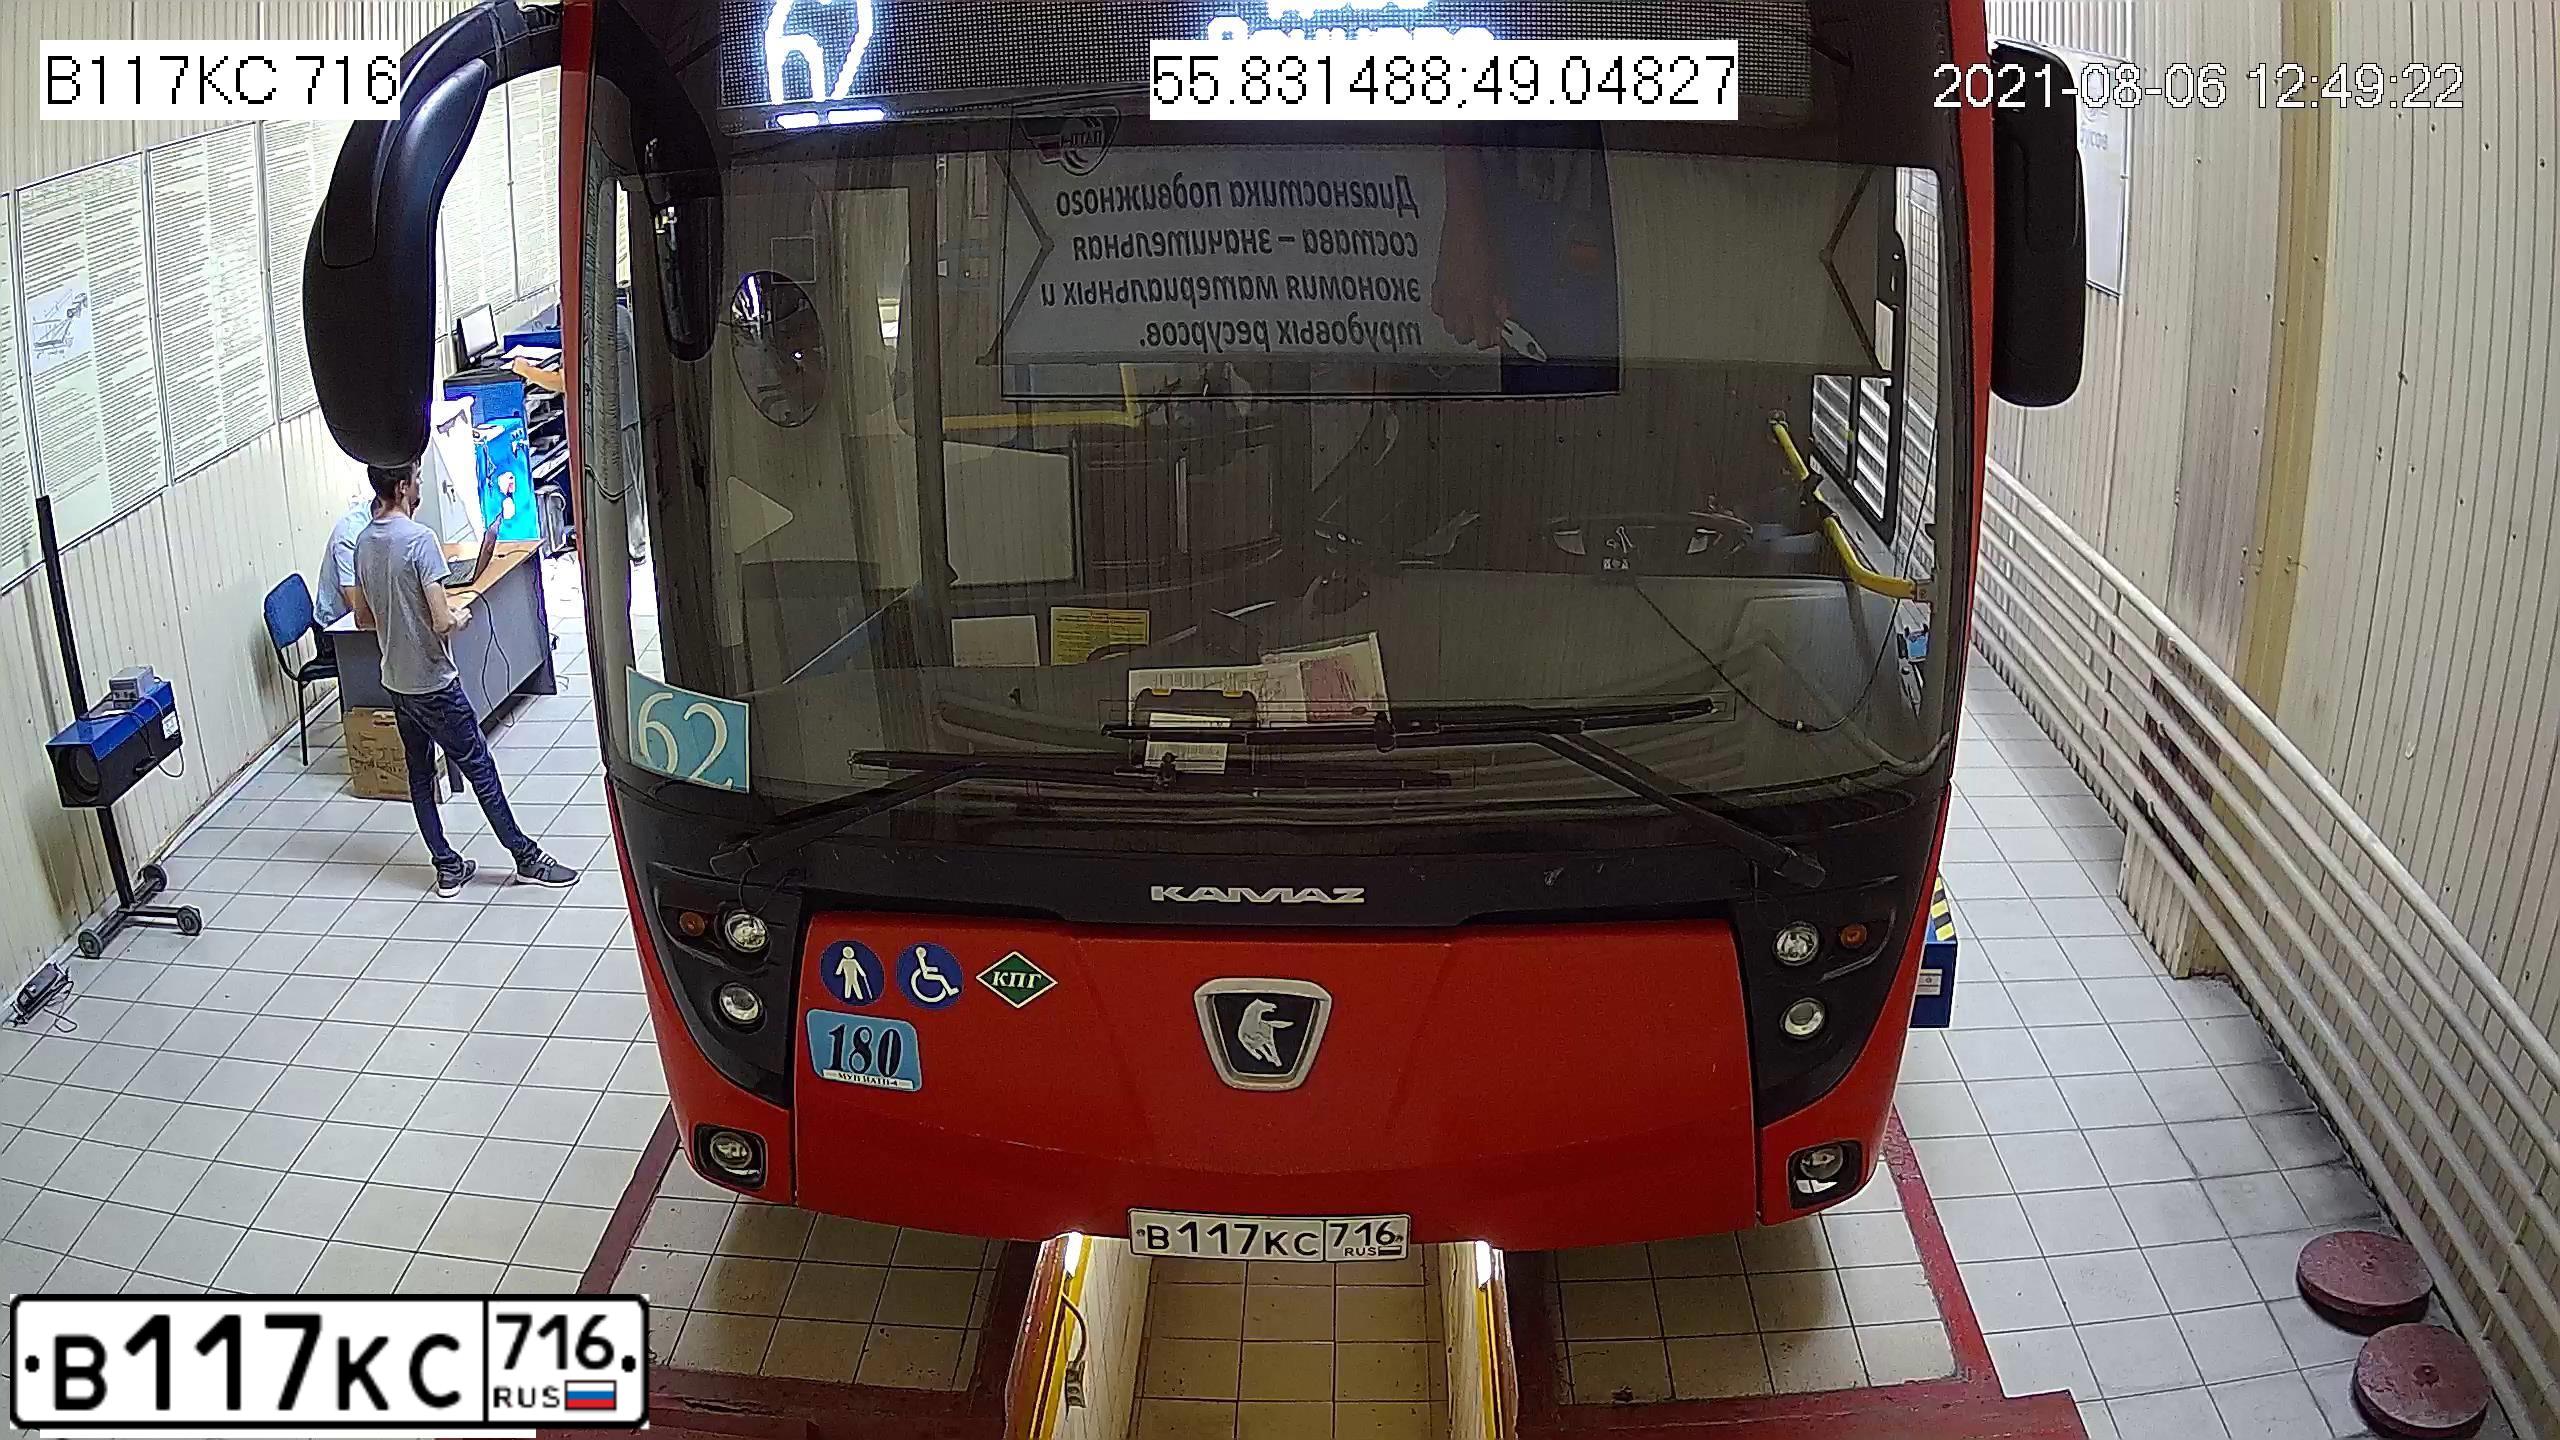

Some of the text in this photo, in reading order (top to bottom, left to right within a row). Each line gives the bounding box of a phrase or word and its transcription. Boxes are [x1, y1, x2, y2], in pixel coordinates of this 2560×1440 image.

[636, 692, 736, 791] 62
[1151, 886, 1365, 903] KAMAZ
[991, 971, 1042, 989] КПГ
[822, 1023, 902, 1078] 180
[1146, 1221, 1396, 1256] В117КС 716
[1344, 1247, 1377, 1257] RUS
